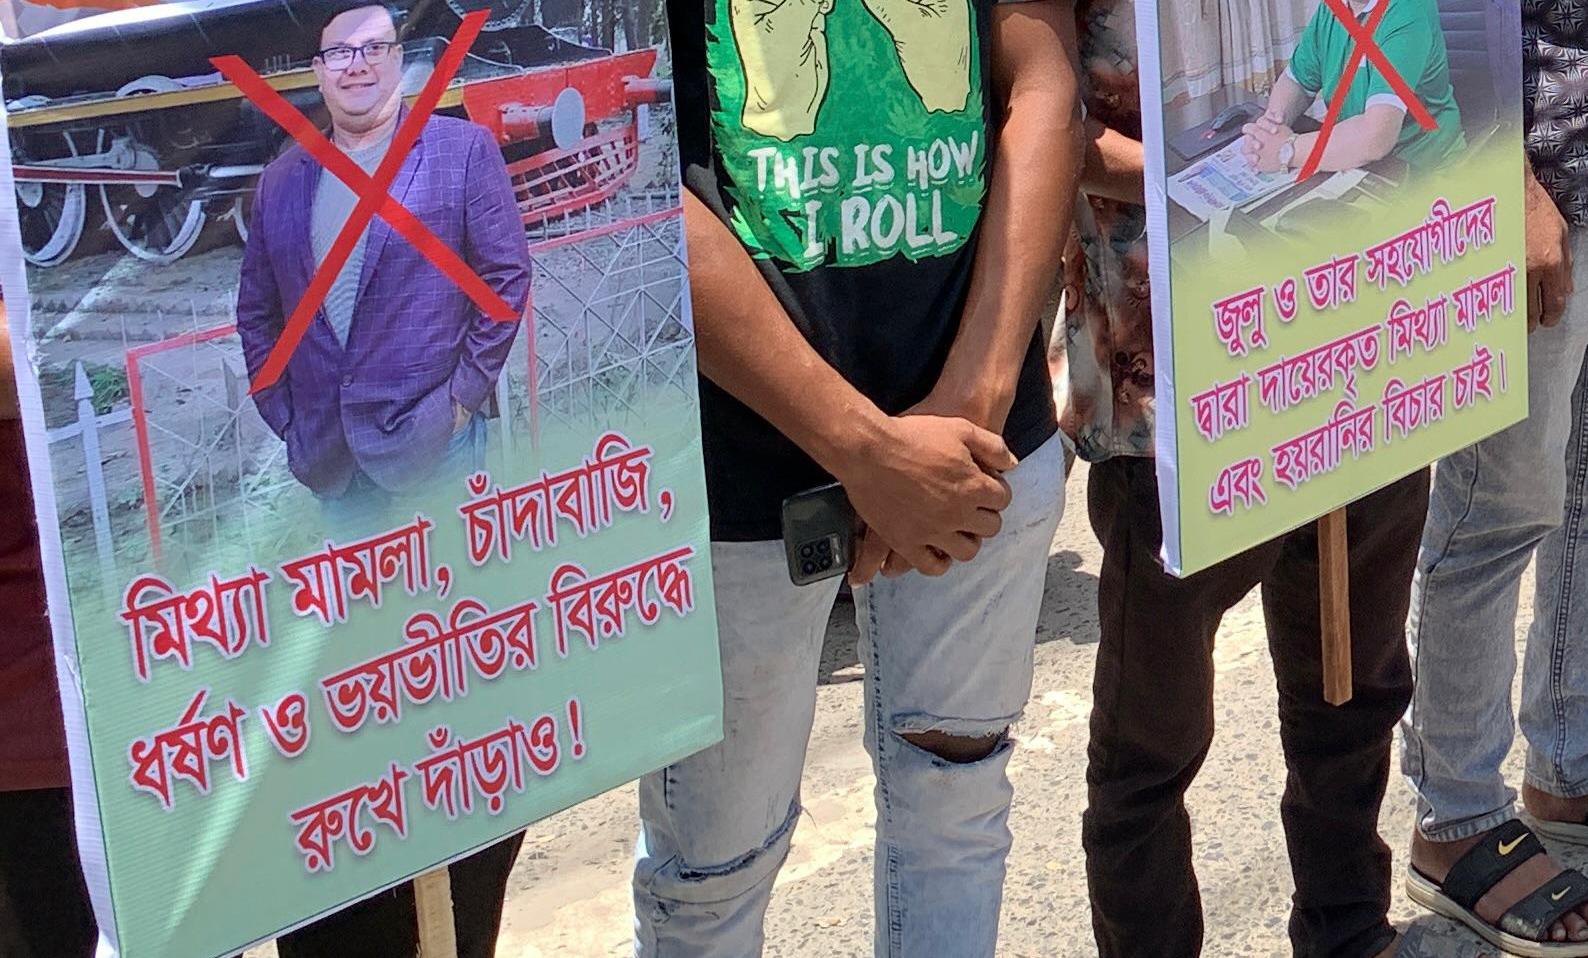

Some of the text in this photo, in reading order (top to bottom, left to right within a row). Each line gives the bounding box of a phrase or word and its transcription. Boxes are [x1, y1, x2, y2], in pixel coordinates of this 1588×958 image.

[746, 129, 979, 199] THIS IS HOW
[803, 188, 958, 258] I ROLL
[1214, 198, 1496, 354] জুলু ও তার সহযোগীদের
[1193, 266, 1515, 440] দ্বারা দায়েরকৃত মিথ্যা মামলা
[1211, 459, 1266, 515] এবং
[1273, 402, 1376, 489] হয়রানির
[1384, 378, 1446, 440] বিচার
[121, 576, 271, 679] মিথ্যা
[131, 547, 694, 808] ধর্ষণ ও ভয়ভীতির বিরুদ্ধে
[292, 763, 407, 871] রুখে
